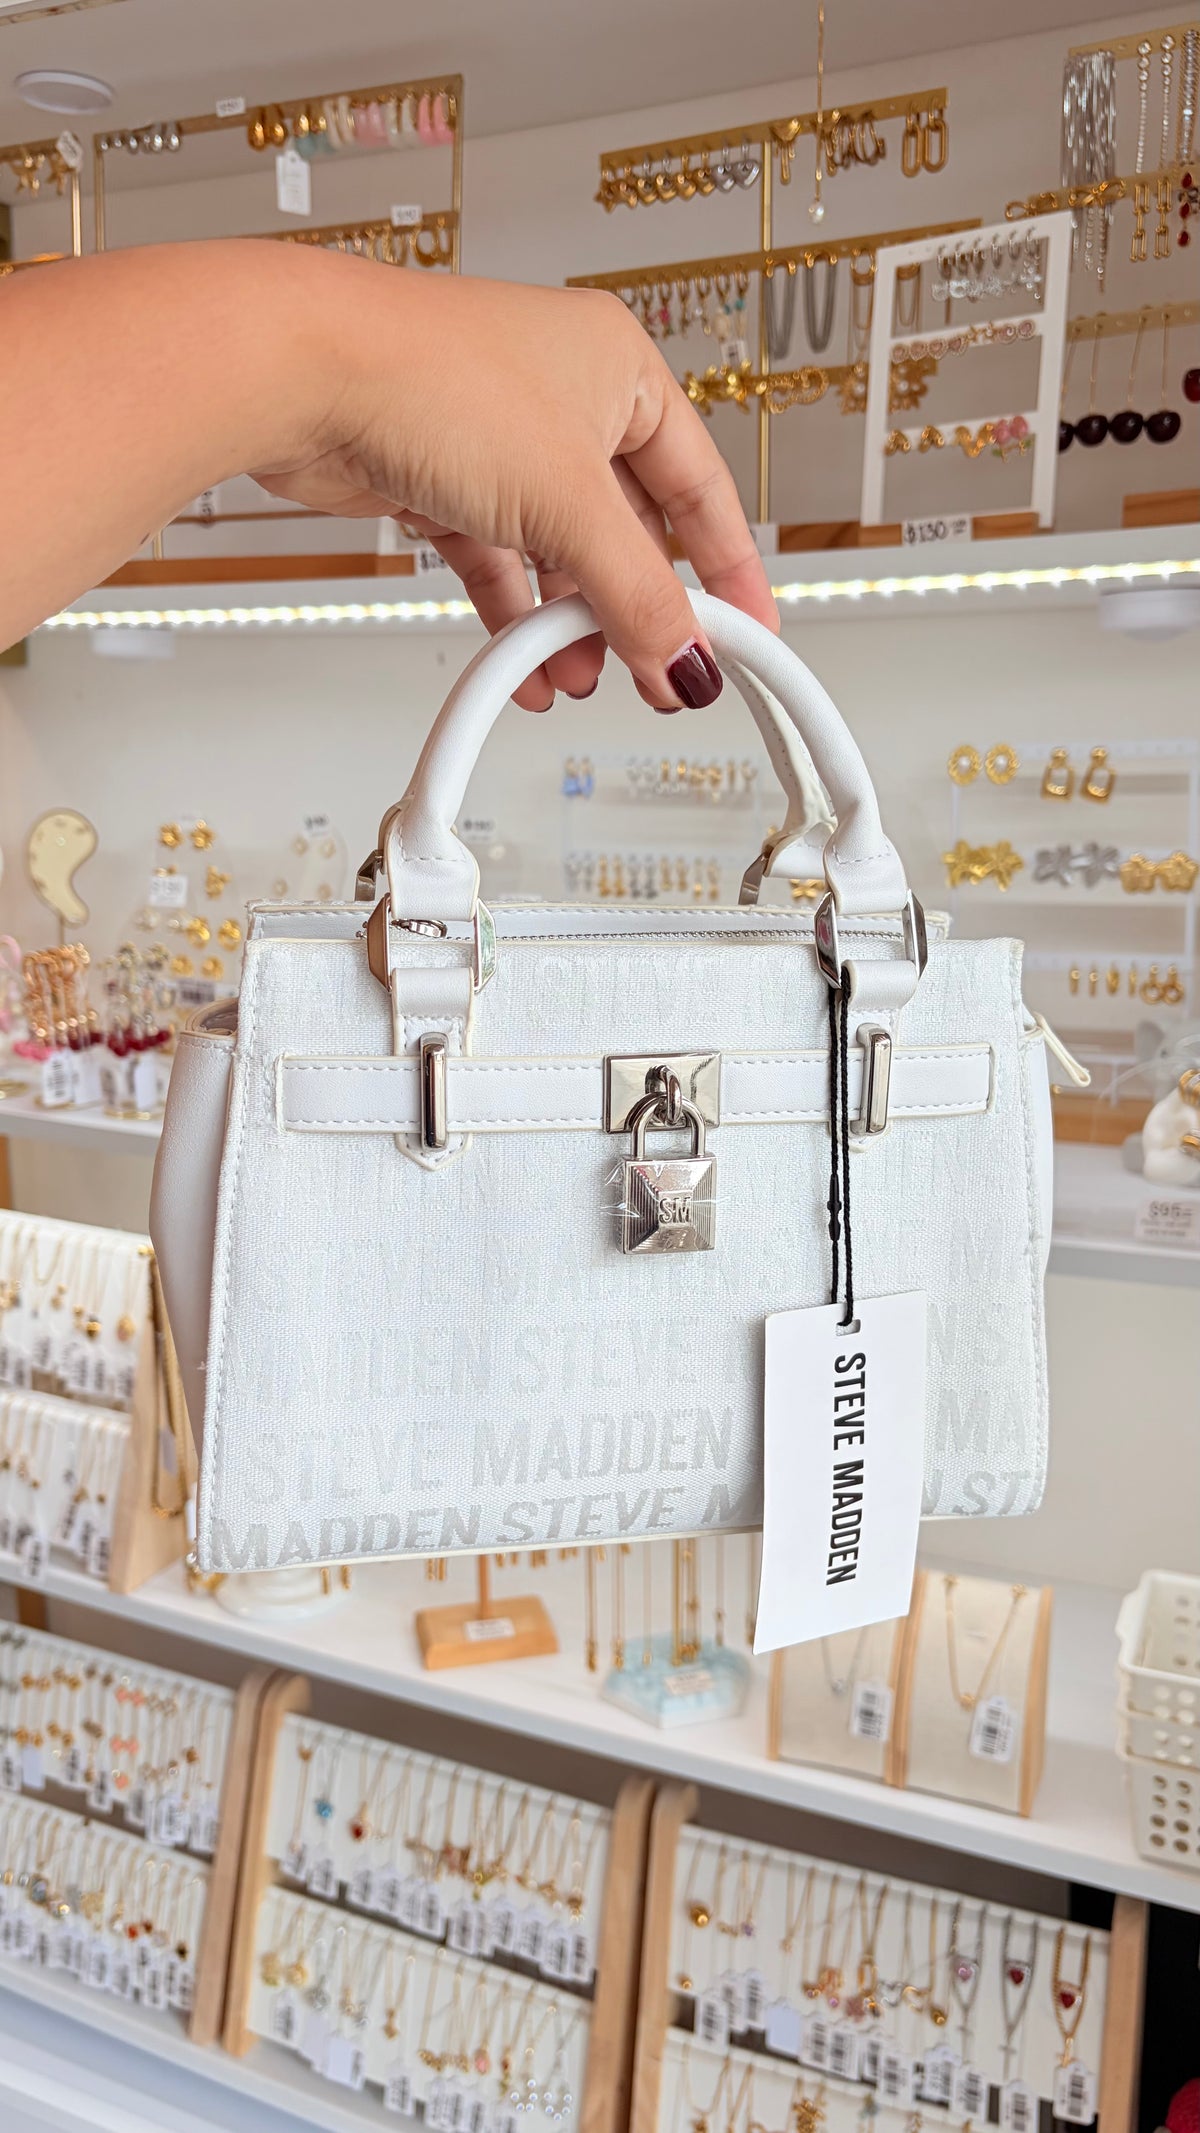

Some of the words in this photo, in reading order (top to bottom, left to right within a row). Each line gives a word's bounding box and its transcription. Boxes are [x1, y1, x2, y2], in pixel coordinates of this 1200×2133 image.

[660, 1196, 692, 1224] SM
[229, 1324, 492, 1406] MADDEN
[509, 1315, 700, 1394] STEVE
[833, 1351, 866, 1452] STEVE
[247, 1418, 449, 1504] STEVE
[471, 1406, 735, 1488] MADDEN
[210, 1504, 482, 1569] MADDEN
[495, 1486, 686, 1543] STEVE
[825, 1458, 864, 1587] MADDEN
